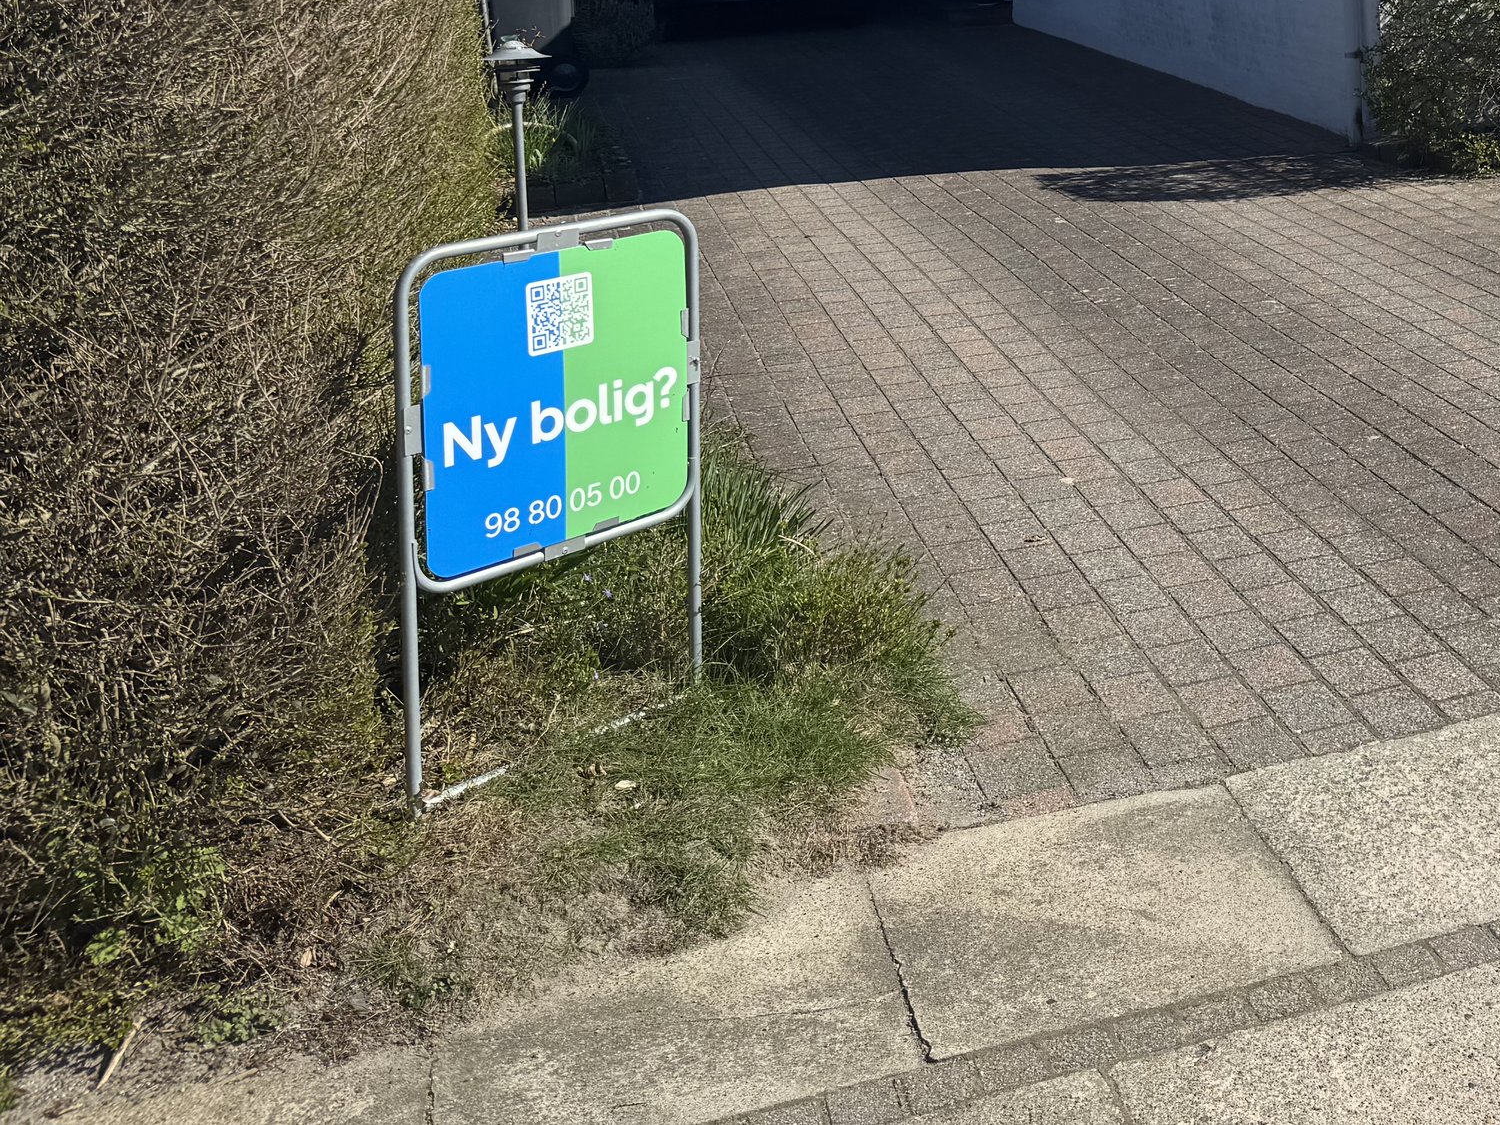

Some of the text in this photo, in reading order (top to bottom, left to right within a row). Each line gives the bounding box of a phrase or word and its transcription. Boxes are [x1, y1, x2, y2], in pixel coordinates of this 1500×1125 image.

[443, 366, 678, 468] Ny bolig?
[485, 471, 641, 538] 98 80 05 00
